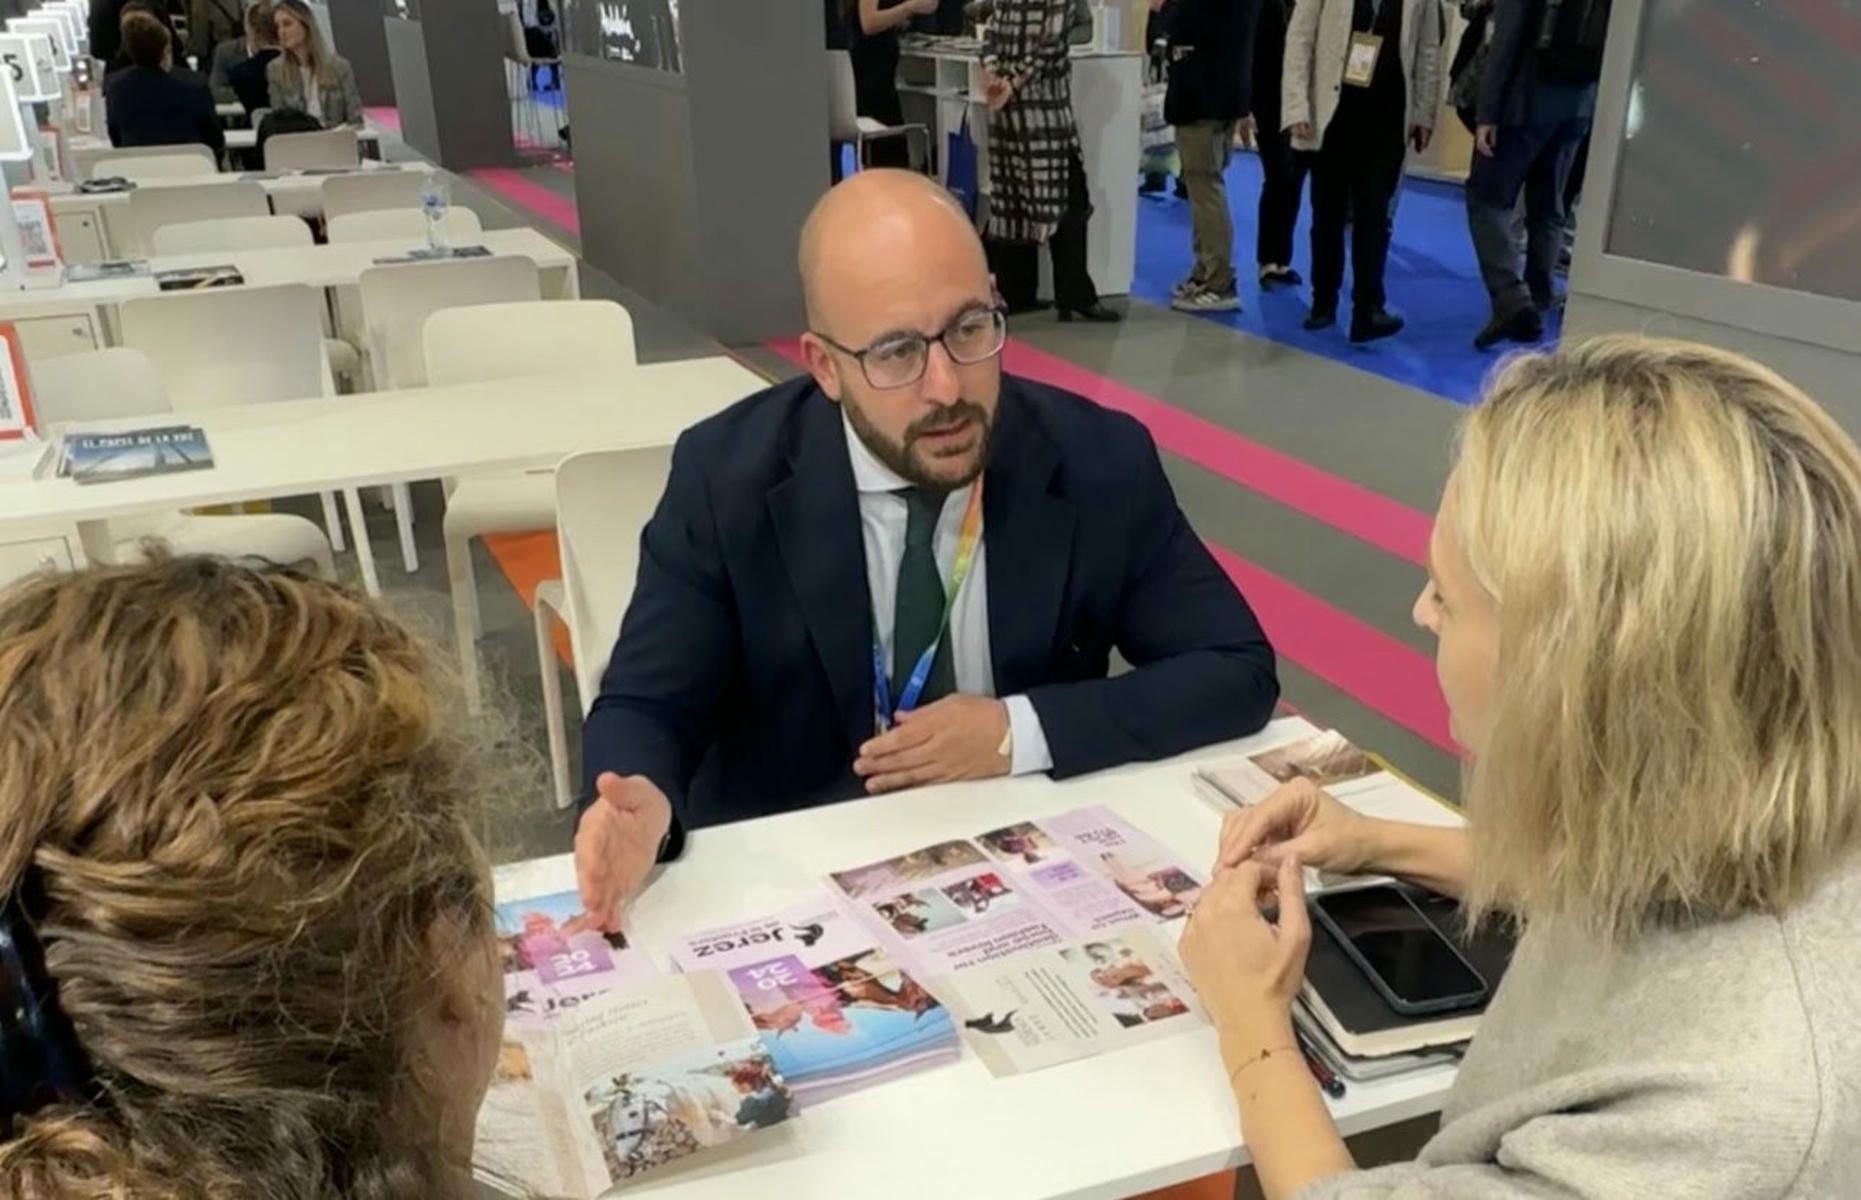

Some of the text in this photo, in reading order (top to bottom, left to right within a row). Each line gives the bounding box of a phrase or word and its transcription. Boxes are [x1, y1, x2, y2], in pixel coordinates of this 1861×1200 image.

[692, 927, 784, 958] Jerez
[747, 961, 789, 980] 24
[756, 975, 798, 991] 20
